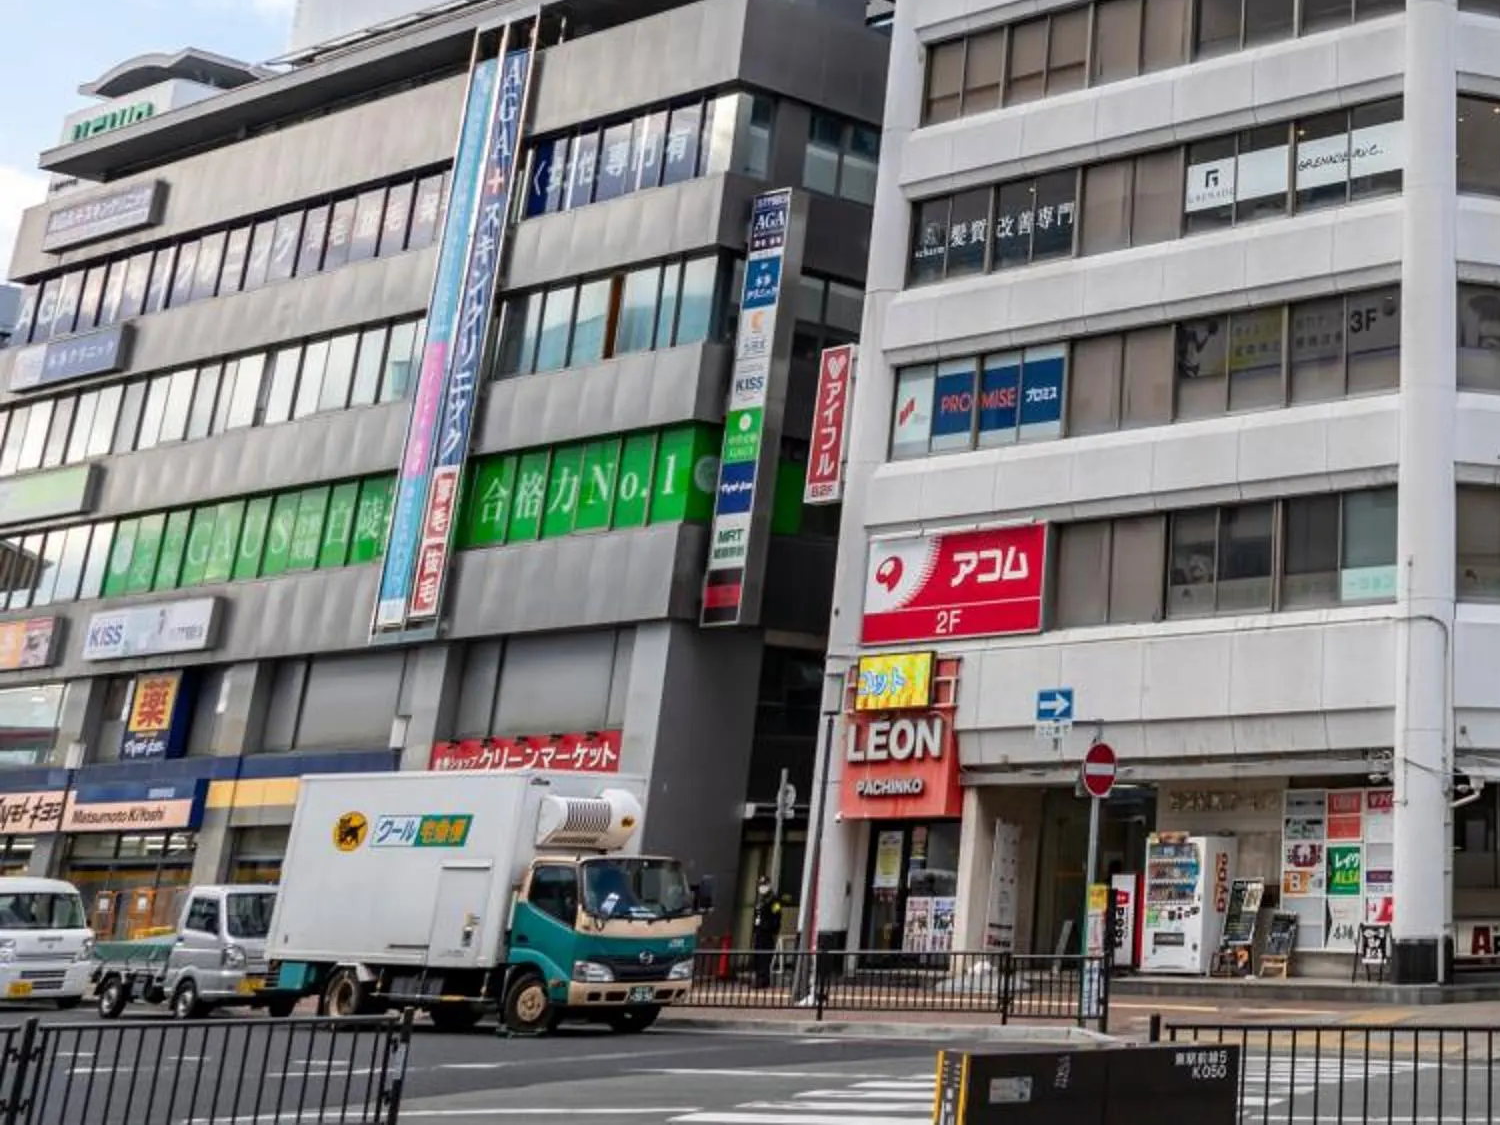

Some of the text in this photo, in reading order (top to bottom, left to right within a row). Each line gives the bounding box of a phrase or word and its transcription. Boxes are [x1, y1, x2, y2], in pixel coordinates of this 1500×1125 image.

[754, 210, 785, 231] AGA
[1349, 307, 1378, 336] 3F
[735, 373, 765, 394] KISS
[939, 385, 1058, 417] PROMISE プロミス
[815, 382, 842, 478] アイフル
[480, 453, 678, 525] 合格力No.1
[950, 546, 1030, 587] アコム
[88, 622, 124, 649] KISS
[935, 610, 961, 635] 2F
[135, 677, 169, 729] 薬
[847, 718, 943, 763] LEON
[478, 741, 618, 771] クリーンマーケット
[855, 778, 924, 796] PACHINKO
[376, 818, 418, 844] クール
